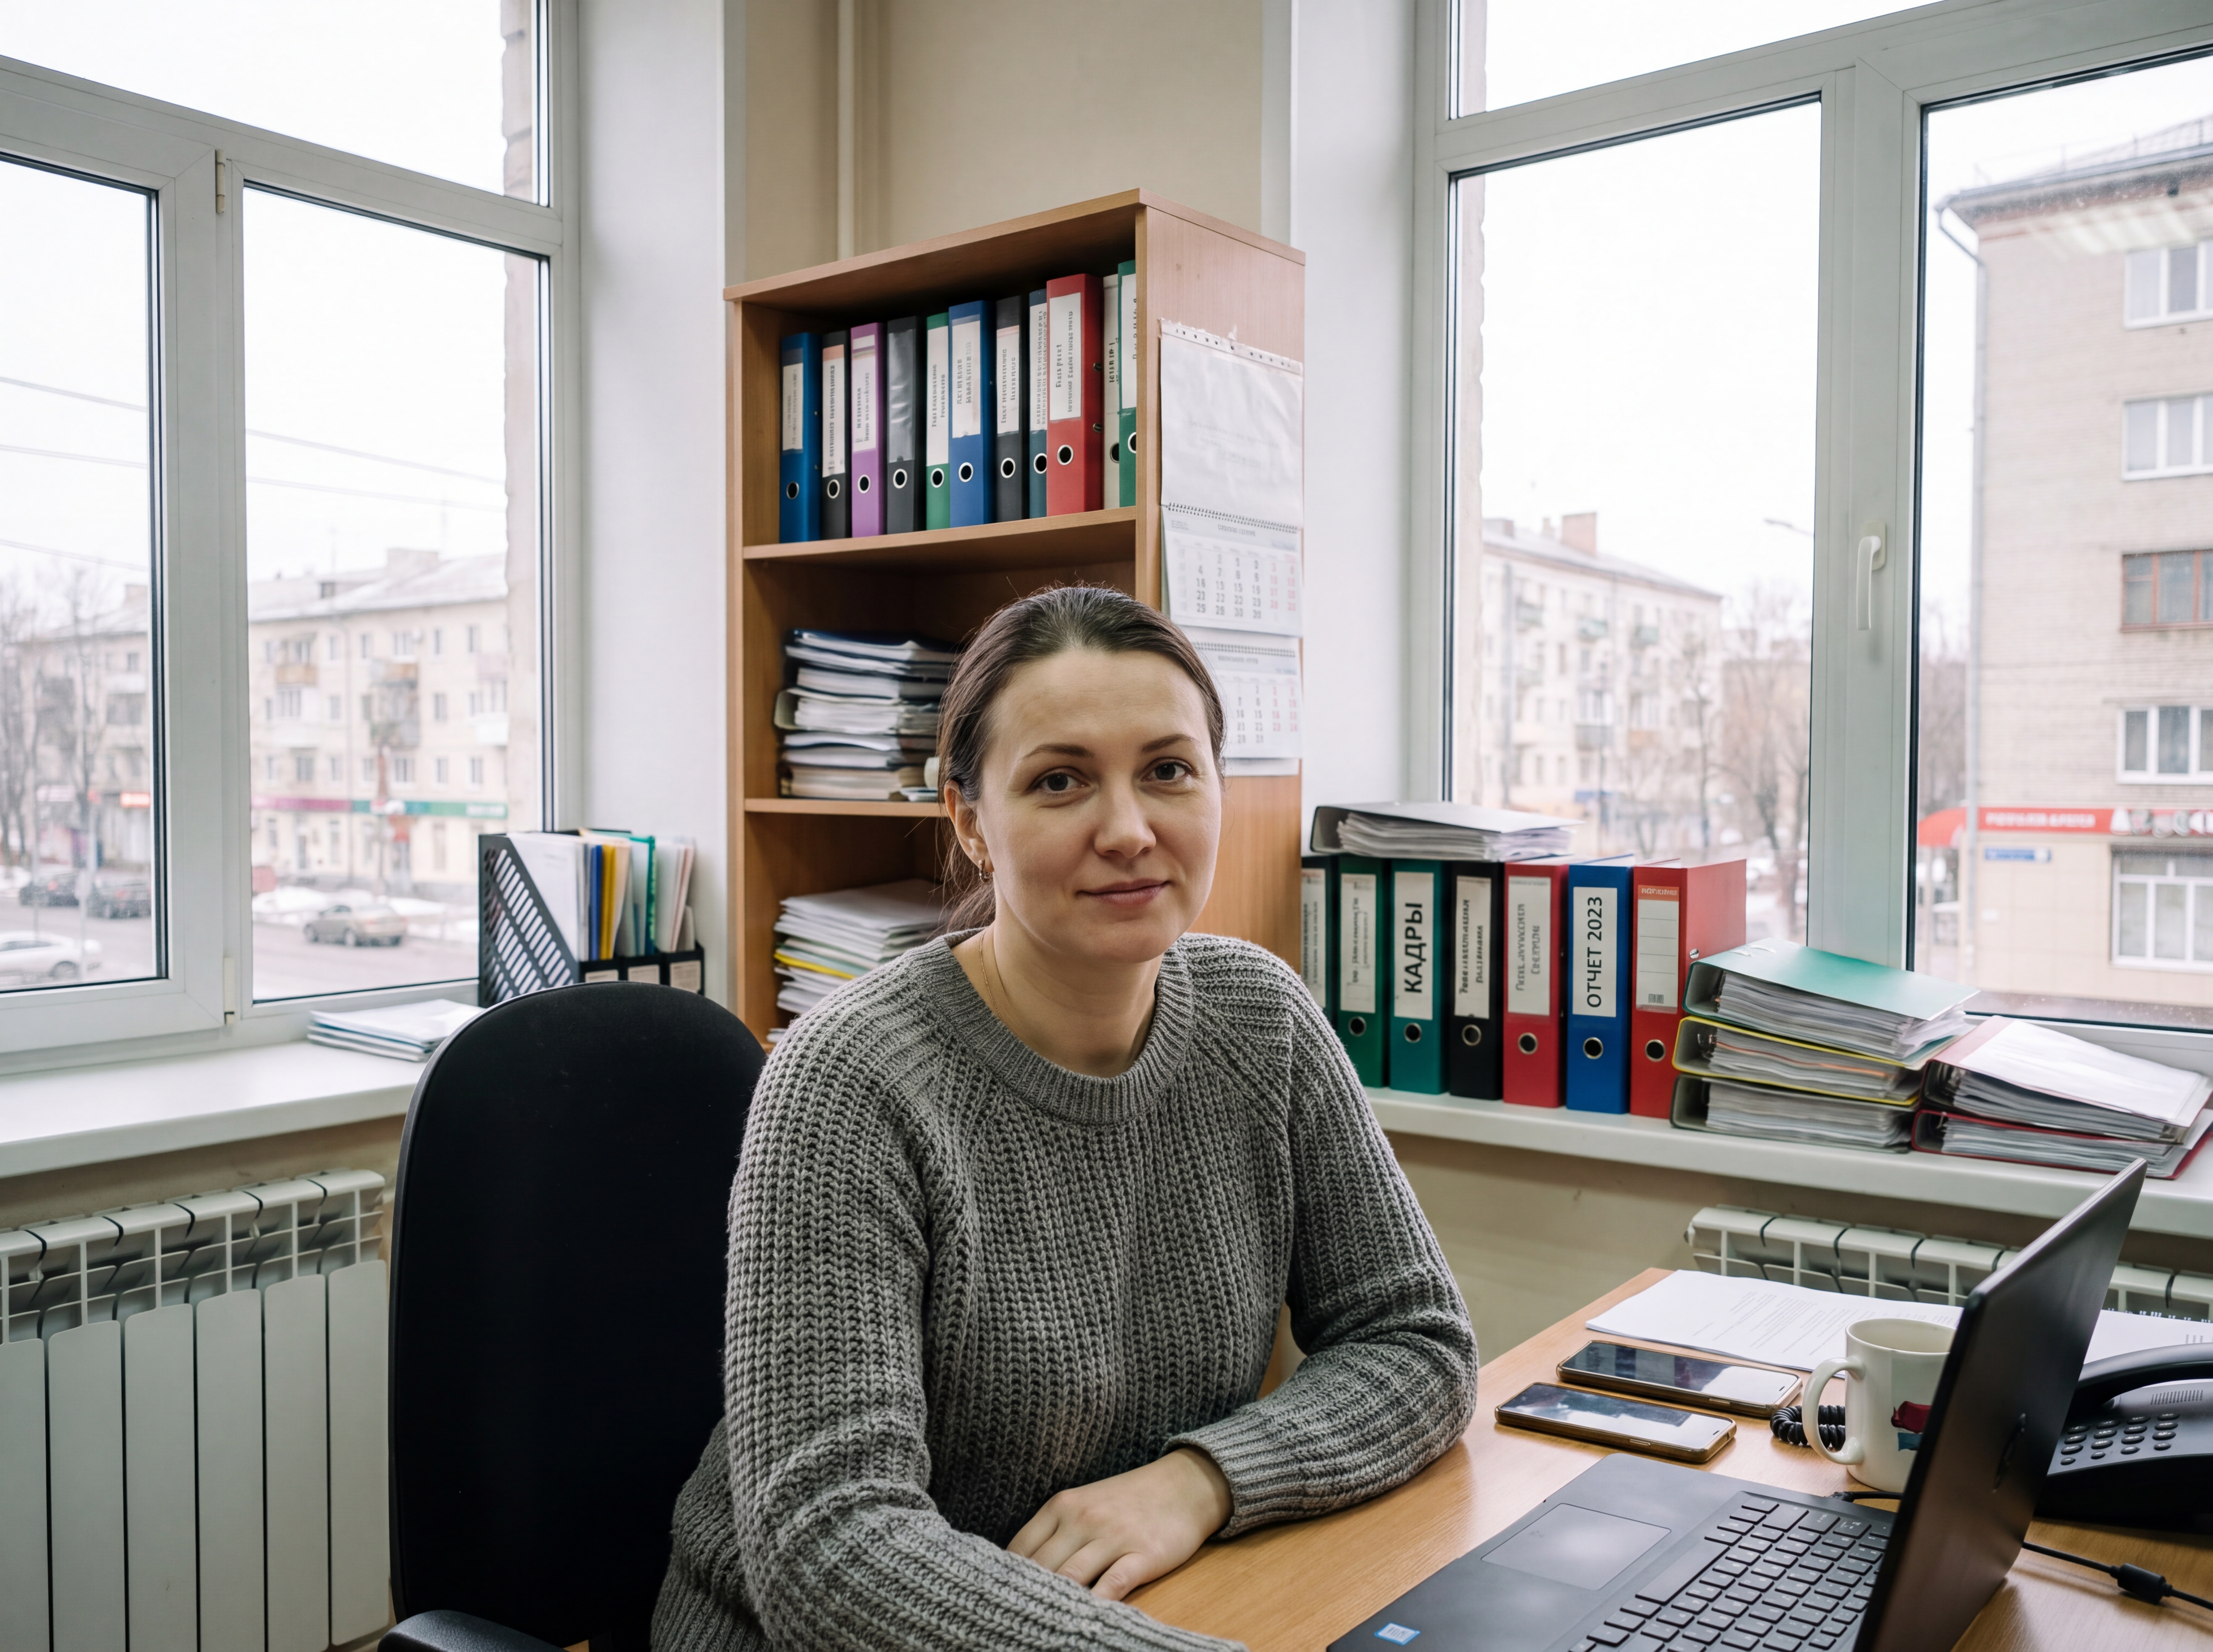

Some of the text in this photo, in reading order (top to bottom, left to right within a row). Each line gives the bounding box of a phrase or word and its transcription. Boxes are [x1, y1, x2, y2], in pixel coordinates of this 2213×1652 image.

[1404, 903, 1426, 994] КАДРЫ
[1587, 897, 1603, 1008] ОТЧЕТ 2023
